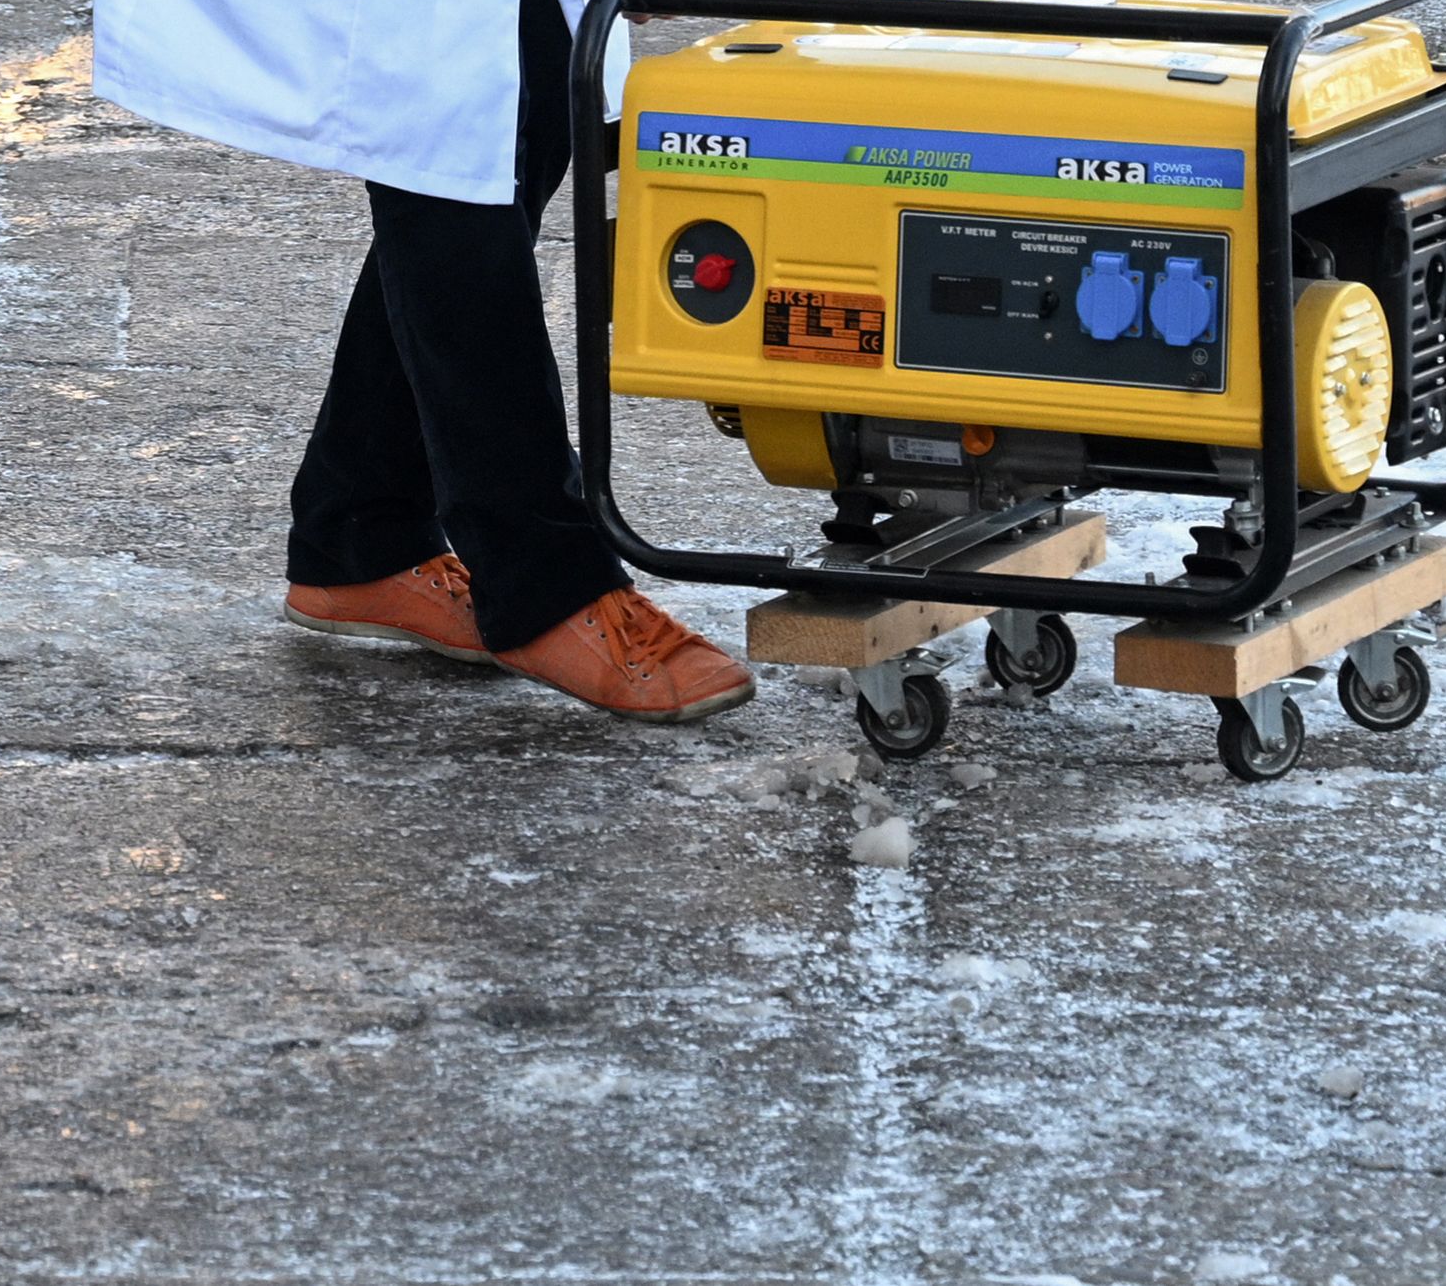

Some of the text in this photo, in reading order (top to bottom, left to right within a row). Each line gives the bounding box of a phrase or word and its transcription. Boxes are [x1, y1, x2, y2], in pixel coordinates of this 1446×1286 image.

[661, 132, 747, 158] aksa
[866, 147, 972, 170] AKSA POWER
[1058, 158, 1147, 185] aksa
[1153, 161, 1193, 175] POWER
[884, 169, 948, 188] AAP3500
[1153, 174, 1224, 189] GENERATION
[964, 227, 997, 238] METER
[1011, 230, 1088, 244] CIRCUIT BREAKER
[1020, 242, 1048, 253] DEVRE
[1131, 239, 1172, 250] AC 230V
[769, 289, 824, 307] aksa
